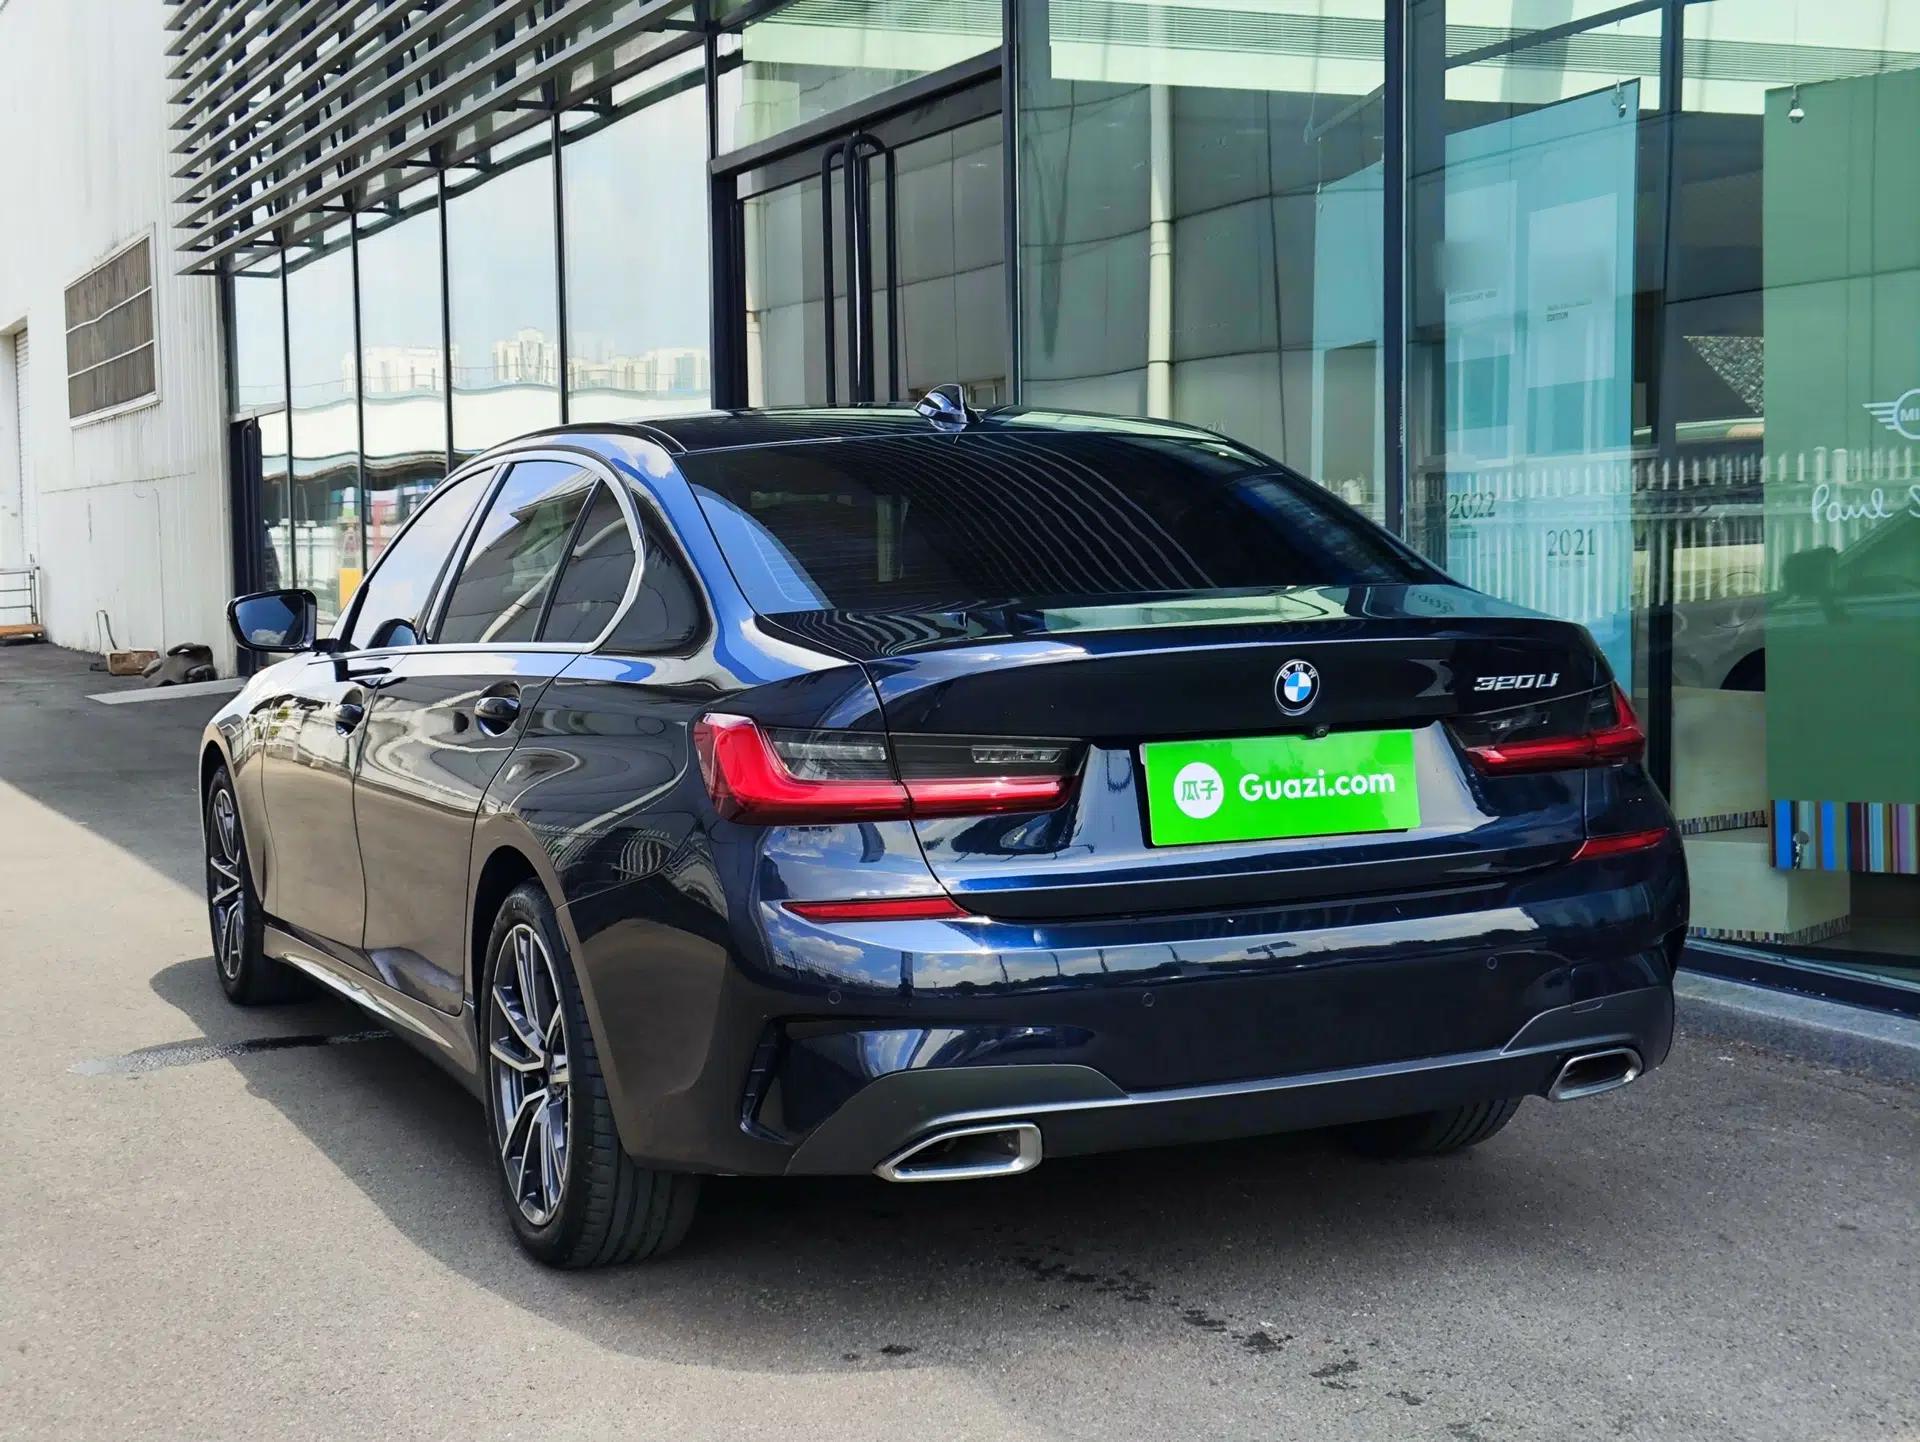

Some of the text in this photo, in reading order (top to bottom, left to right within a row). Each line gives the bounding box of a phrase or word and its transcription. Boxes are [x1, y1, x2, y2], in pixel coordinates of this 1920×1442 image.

[1449, 491, 1496, 519] 2022
[1811, 484, 1894, 524] Paul
[1547, 528, 1595, 557] 2021
[1280, 663, 1317, 680] BMW
